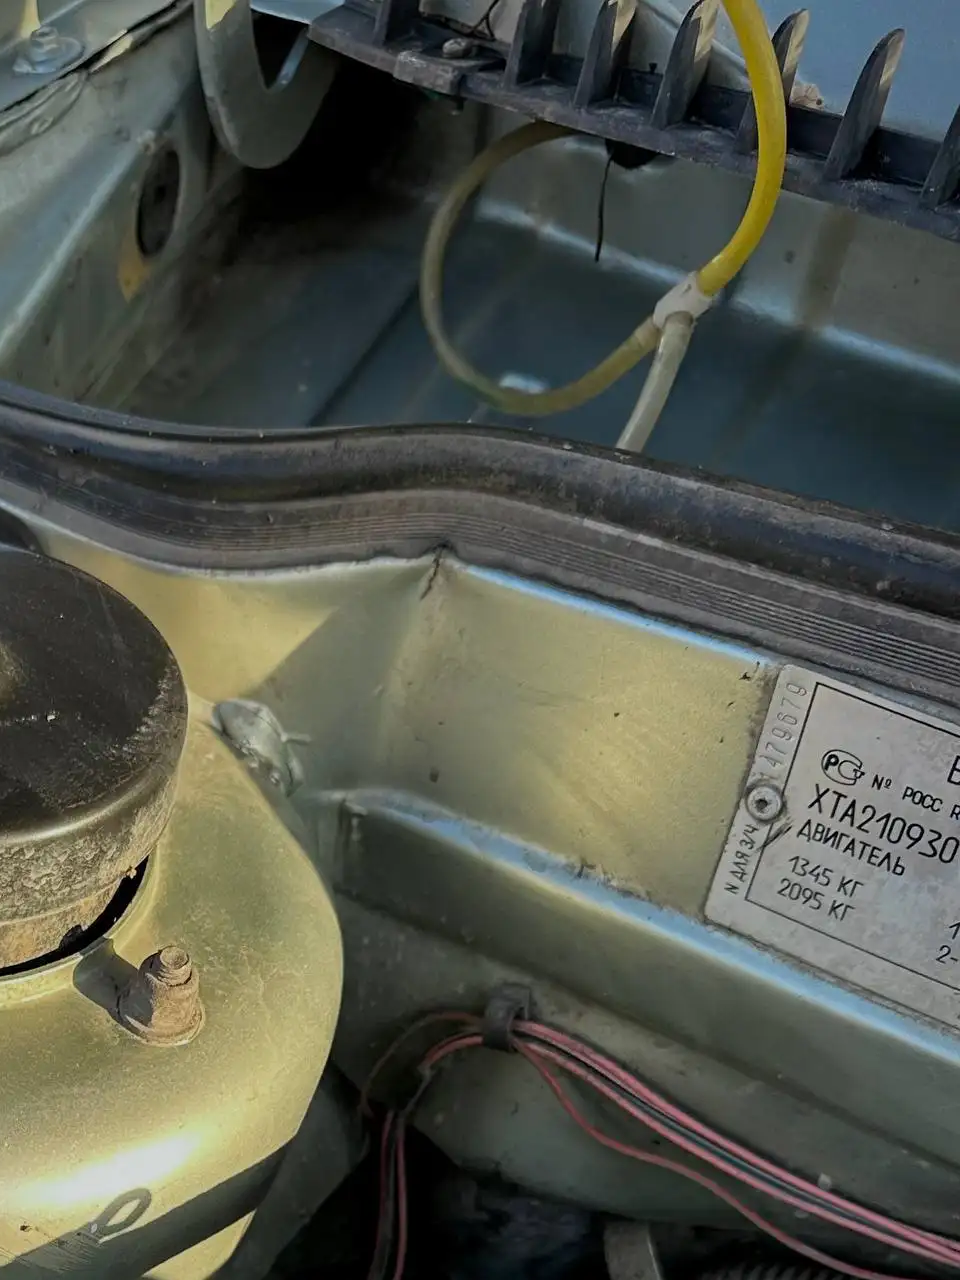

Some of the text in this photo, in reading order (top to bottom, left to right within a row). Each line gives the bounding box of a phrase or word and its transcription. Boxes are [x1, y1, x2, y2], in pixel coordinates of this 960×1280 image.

[901, 786, 944, 813] РОСС
[809, 783, 960, 864] XTA210930
[796, 819, 905, 877] ДВИГАТЕЛЬ
[788, 855, 864, 899] 1345 КГ
[777, 878, 857, 922] 2095 КГ
